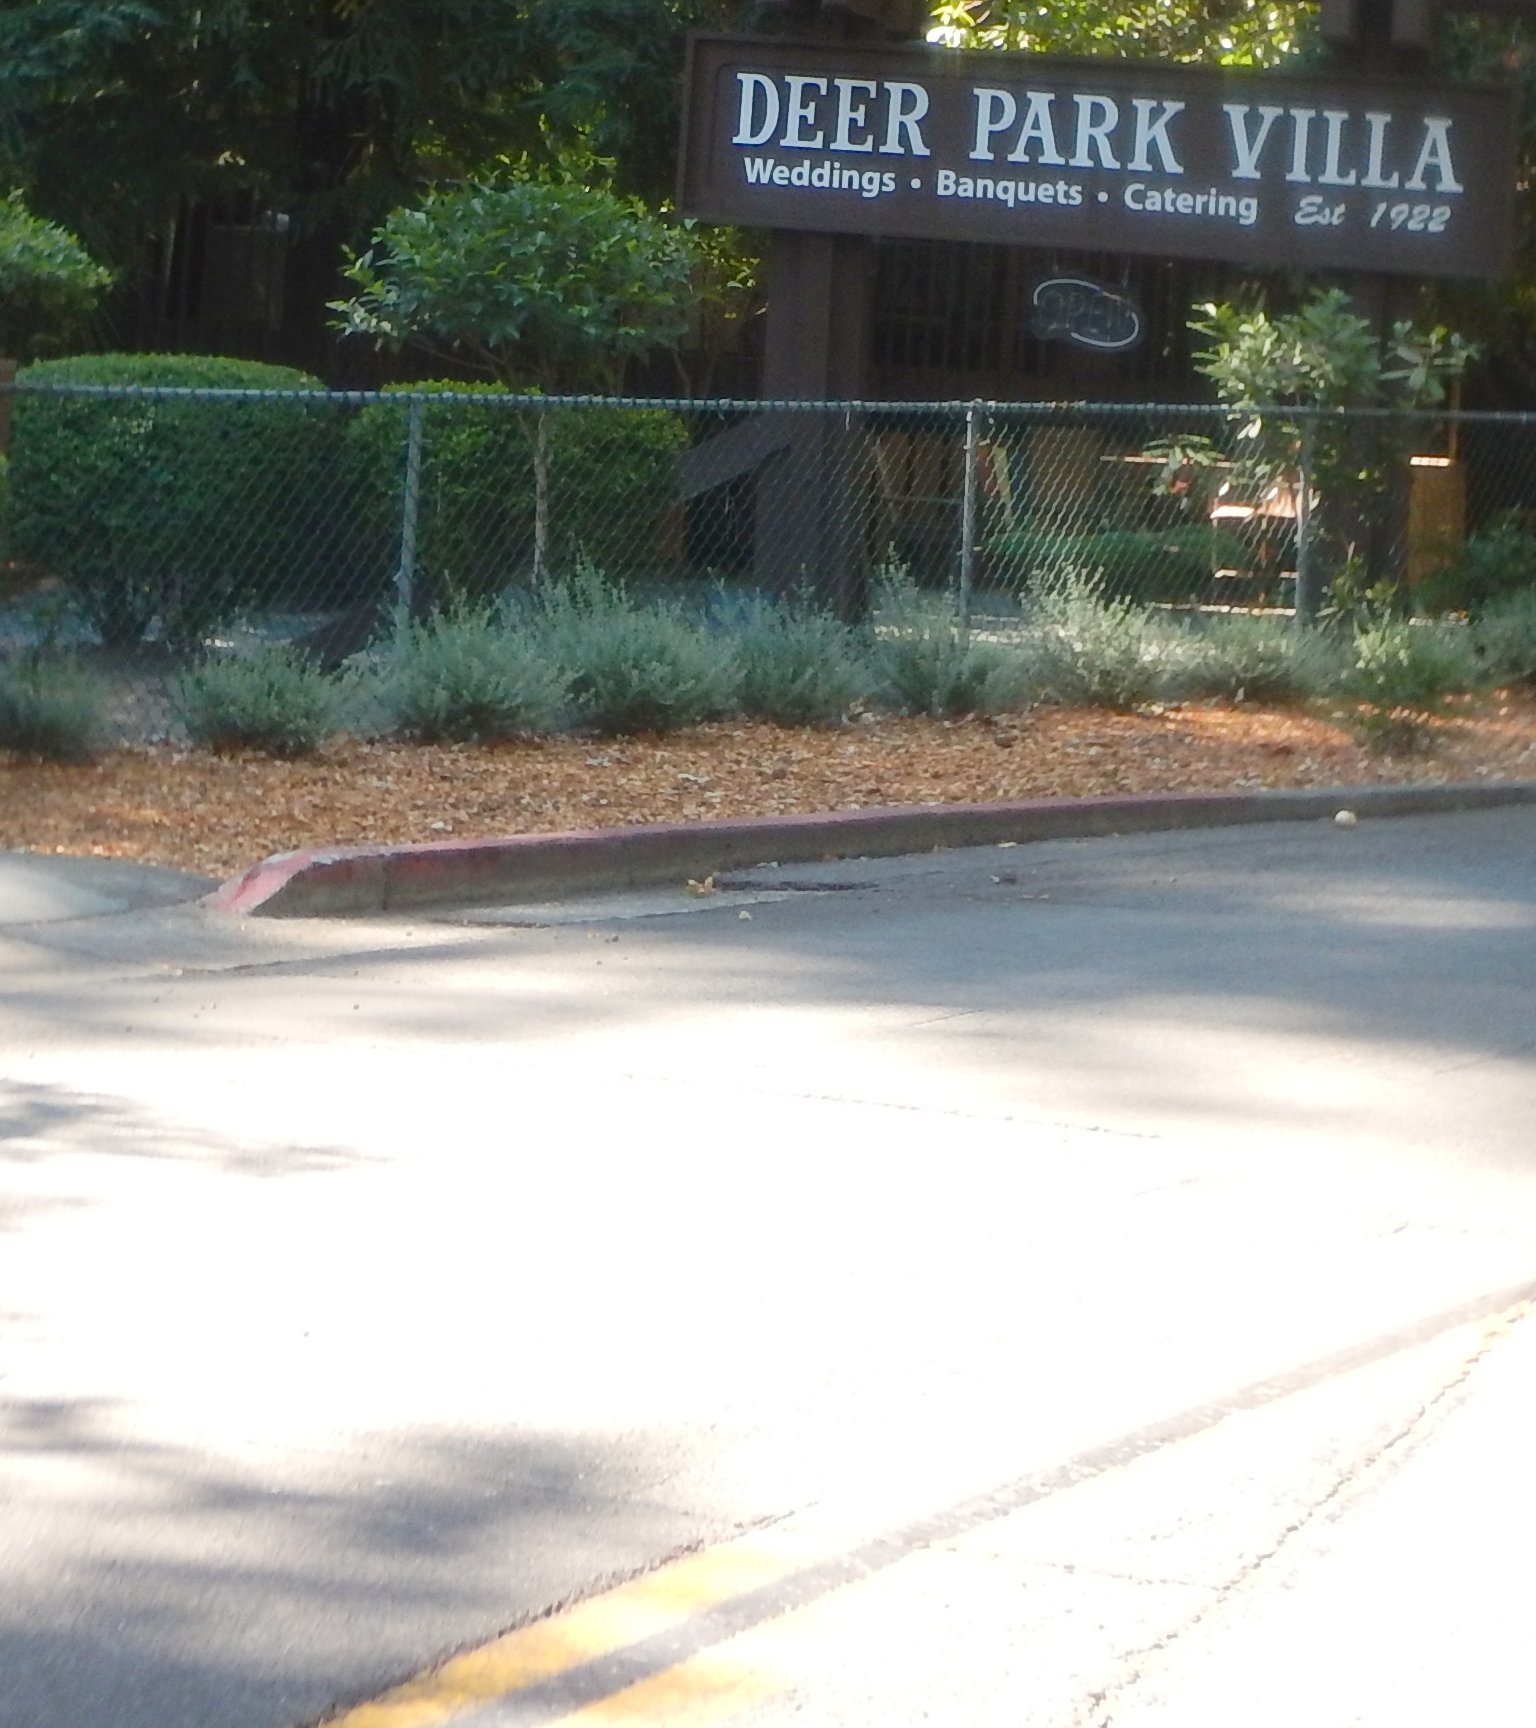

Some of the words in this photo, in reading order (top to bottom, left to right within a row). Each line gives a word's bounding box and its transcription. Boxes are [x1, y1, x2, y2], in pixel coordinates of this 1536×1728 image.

[732, 72, 931, 157] DEER
[969, 87, 1185, 174] PARK
[1223, 103, 1464, 194] VILLA
[744, 156, 896, 198] Weddings
[936, 169, 1083, 208] Banquets
[1124, 183, 1259, 225] Catering
[1294, 195, 1346, 226] Est
[1369, 202, 1452, 233] 1922
